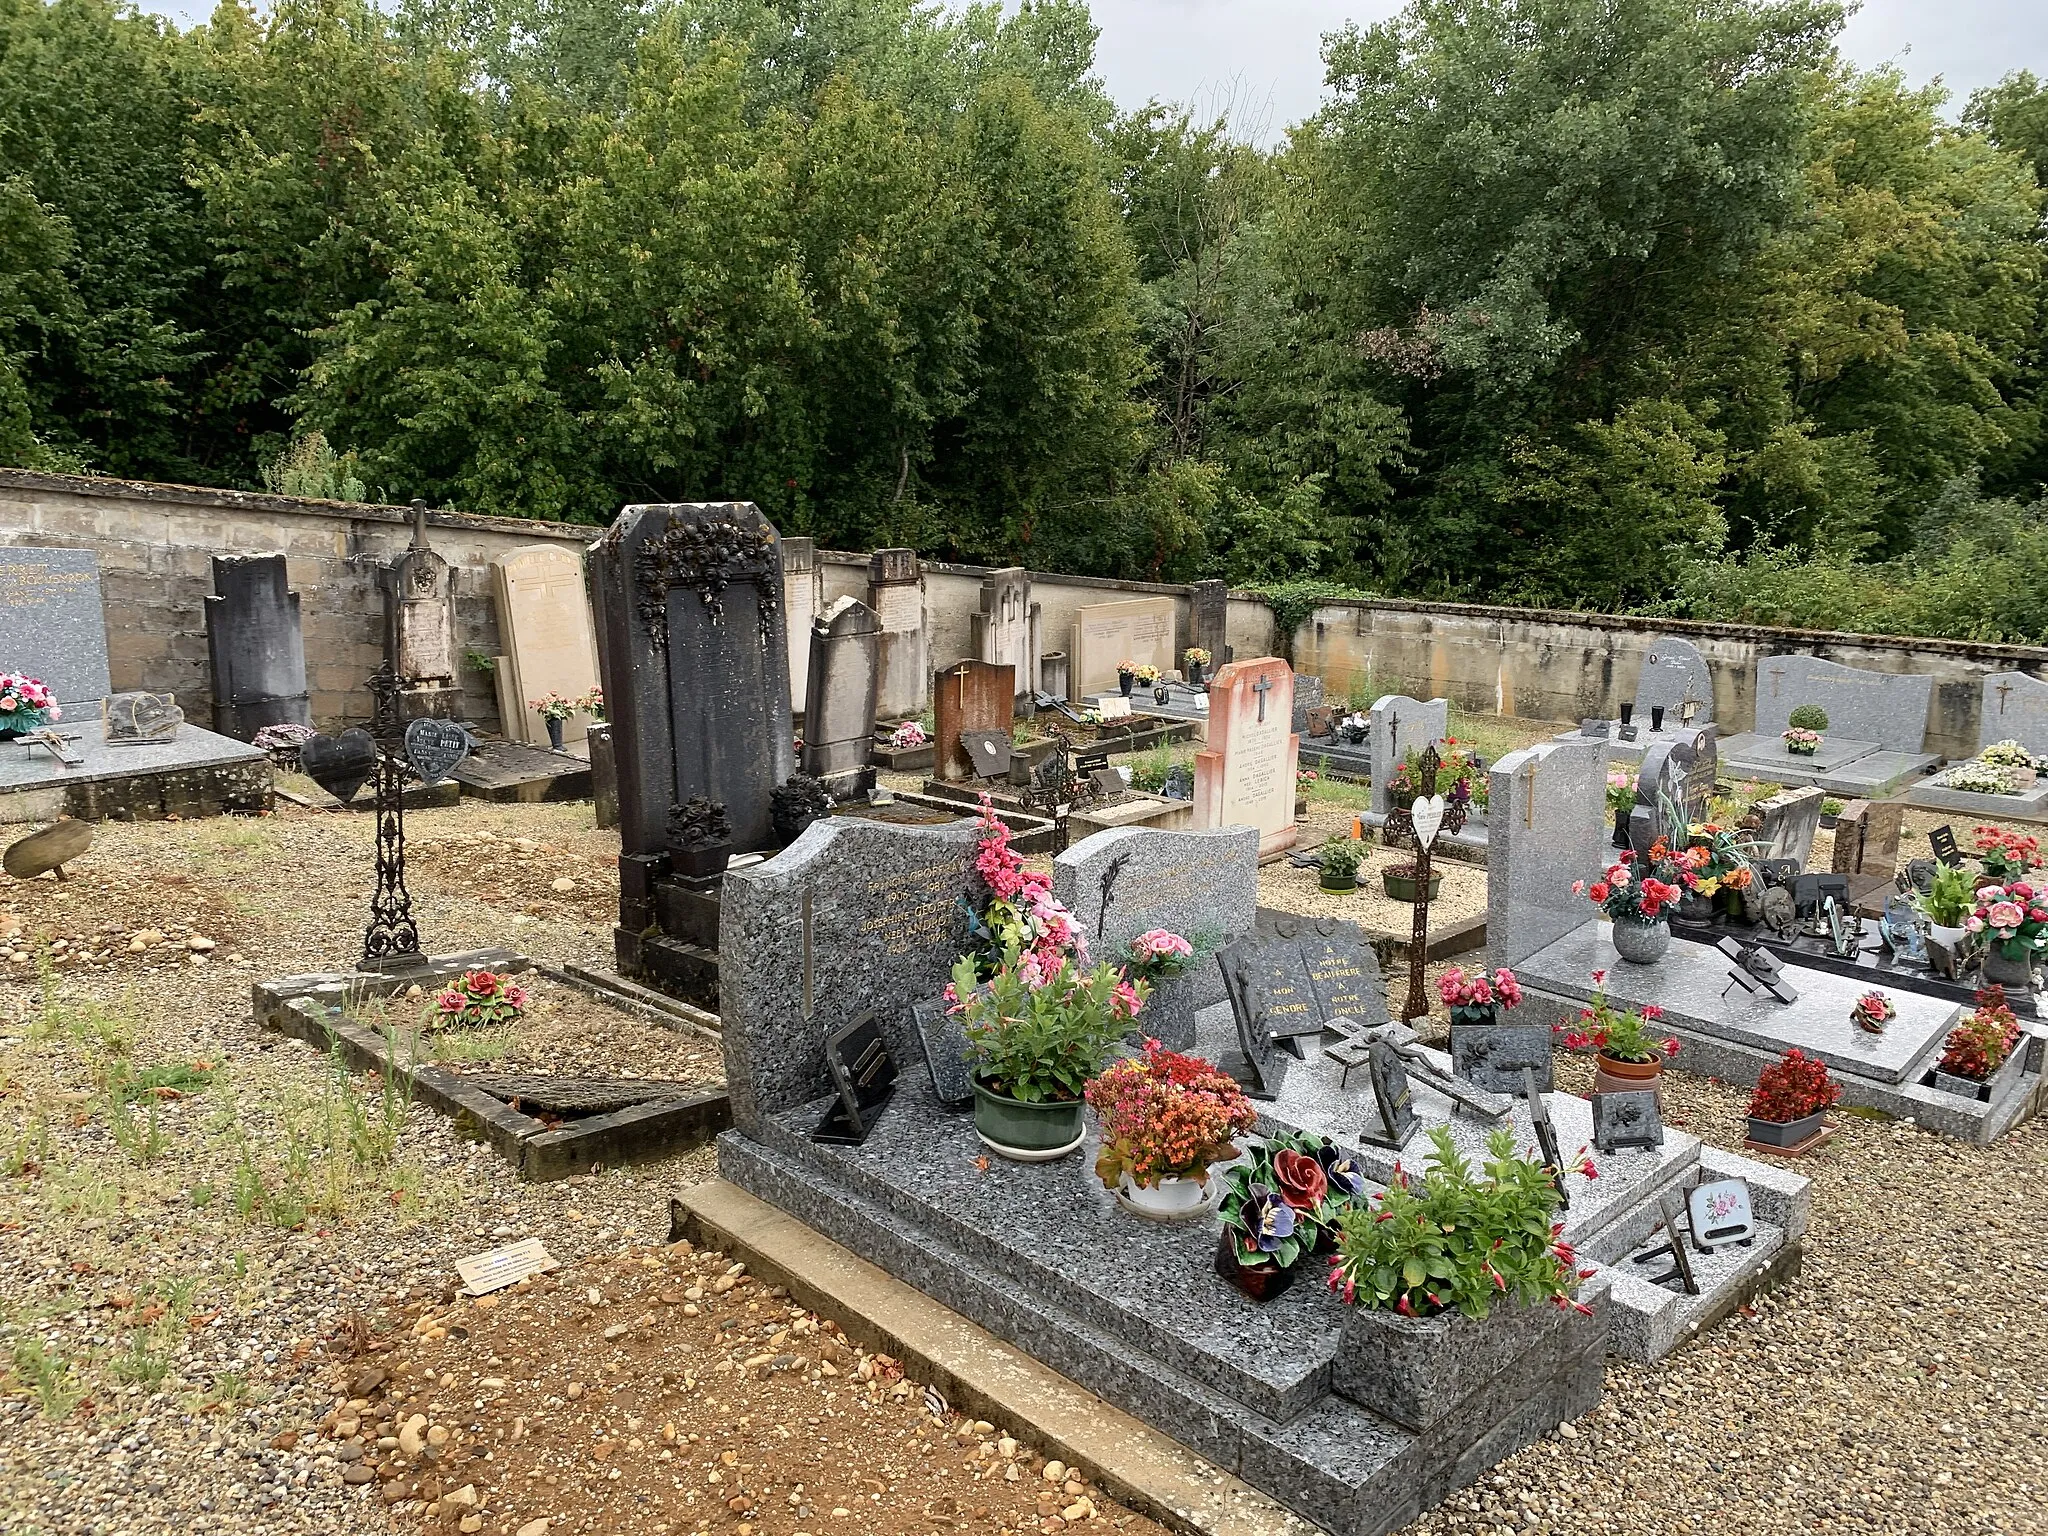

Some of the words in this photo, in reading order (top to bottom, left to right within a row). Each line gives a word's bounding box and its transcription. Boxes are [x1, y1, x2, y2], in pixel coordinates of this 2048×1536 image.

[1319, 957, 1349, 967] NOTRE
[1273, 987, 1294, 995] MON
[1331, 994, 1360, 1004] NOTRE
[1269, 1003, 1309, 1015] GENDRE
[1334, 1004, 1367, 1016] ONCLE
